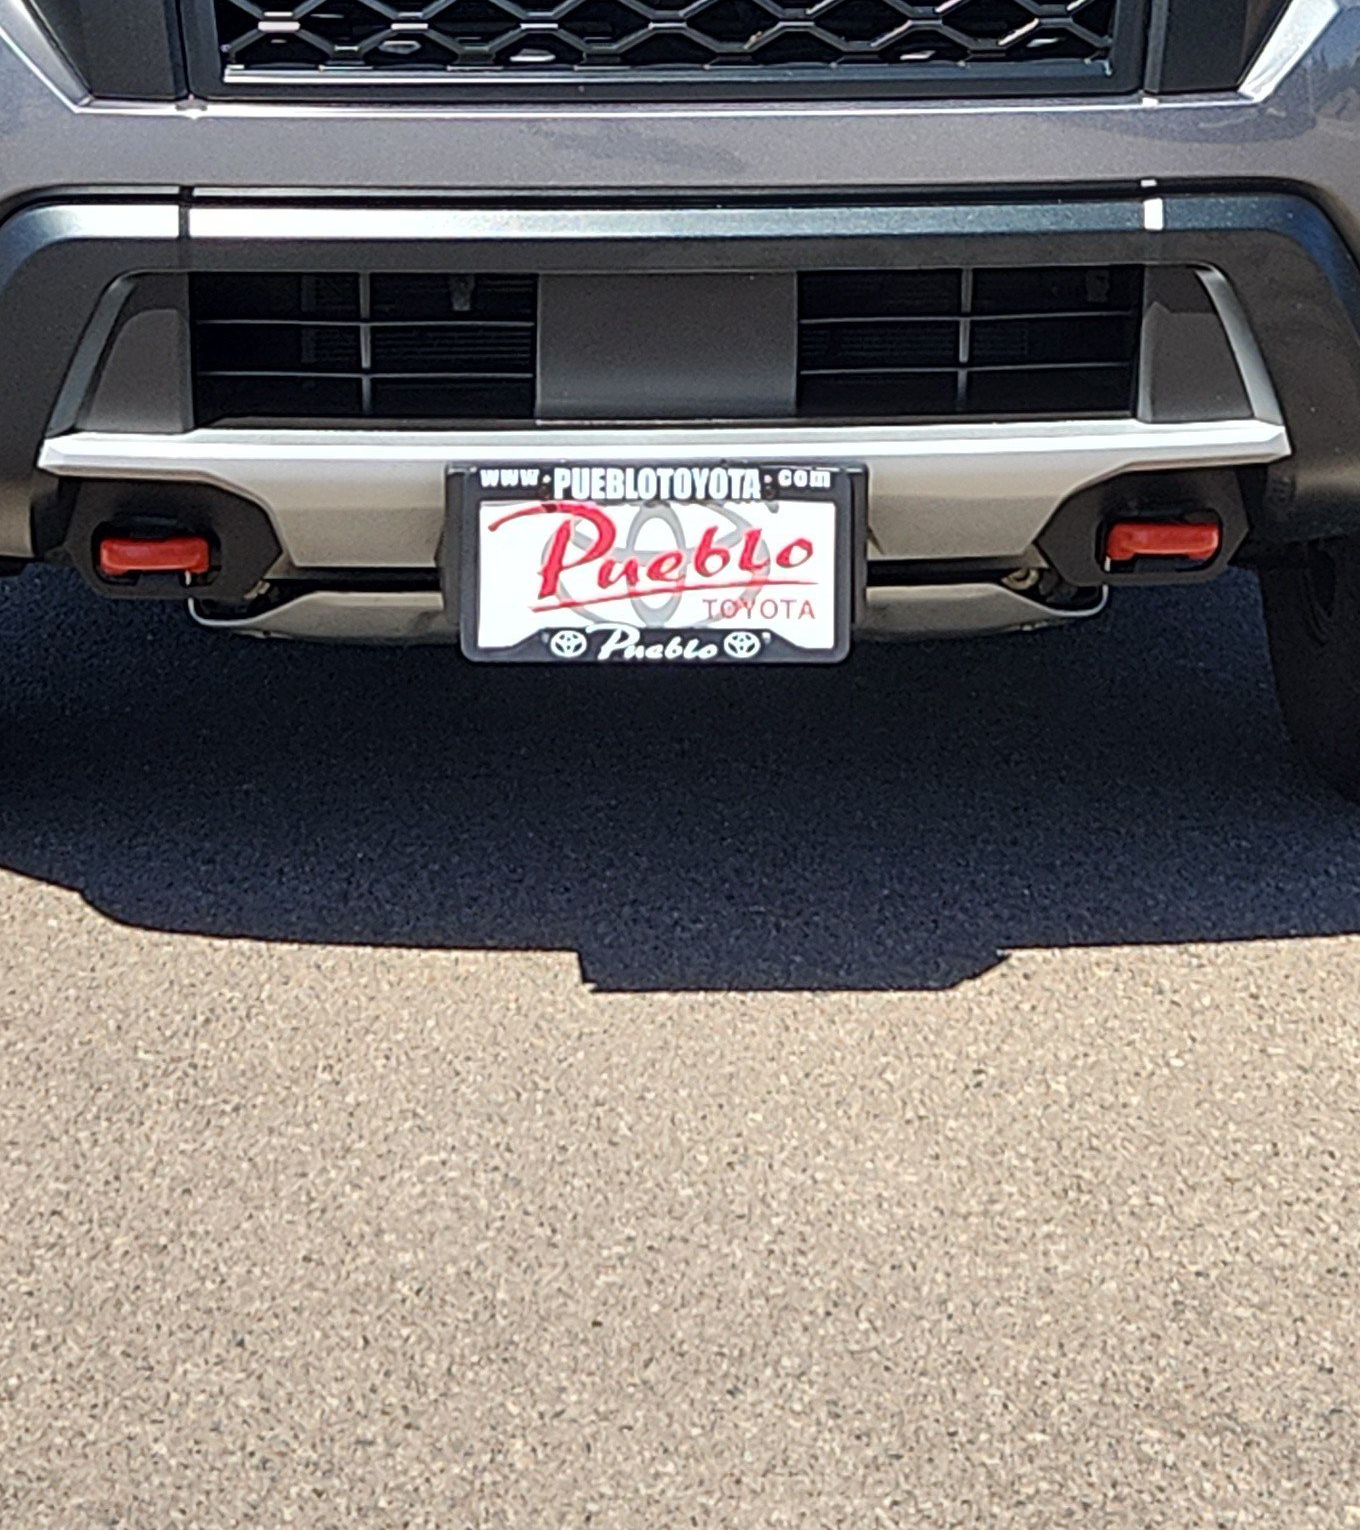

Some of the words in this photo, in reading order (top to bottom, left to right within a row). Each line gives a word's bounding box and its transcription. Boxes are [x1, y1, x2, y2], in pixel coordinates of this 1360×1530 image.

[488, 502, 814, 600] Pueblo
[702, 598, 816, 620] TOYOTA
[585, 623, 718, 660] Pueblo
